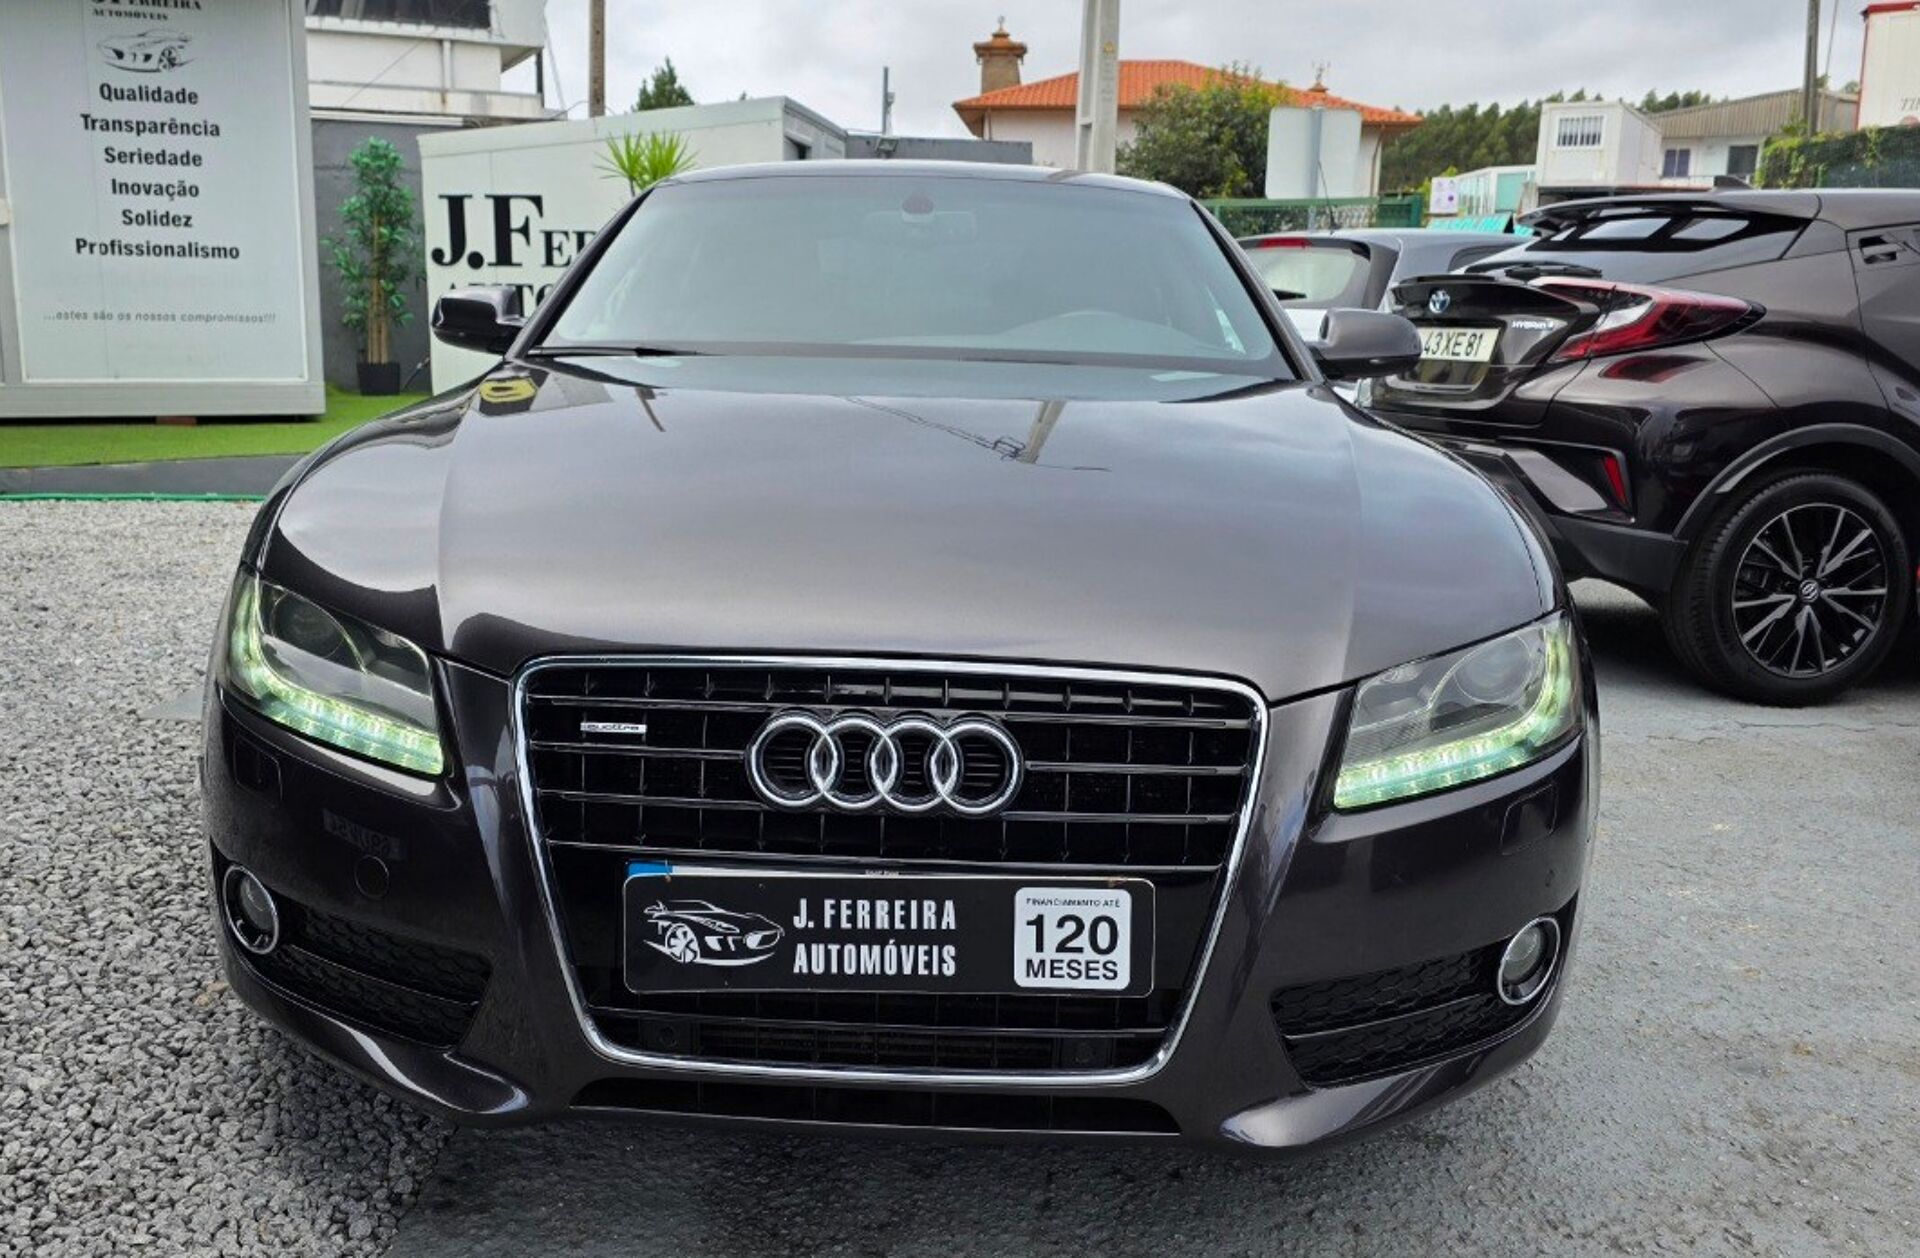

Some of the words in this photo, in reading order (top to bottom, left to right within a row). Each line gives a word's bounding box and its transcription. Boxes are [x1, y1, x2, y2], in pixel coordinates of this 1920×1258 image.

[99, 83, 199, 105] Qualidade
[80, 113, 221, 136] Transparência
[104, 146, 203, 167] Seriedade
[111, 178, 200, 201] Inovação
[121, 209, 193, 228] Solidez
[75, 238, 240, 260] Profissionalismo
[93, 310, 113, 321] são
[117, 312, 132, 321] os
[135, 312, 176, 322] nossos
[793, 898, 814, 928] J.
[824, 899, 956, 929] FERREIRA
[1026, 914, 1119, 956] 120
[793, 939, 956, 976] AUTOMÓVEIS
[1026, 959, 1118, 980] MESES
